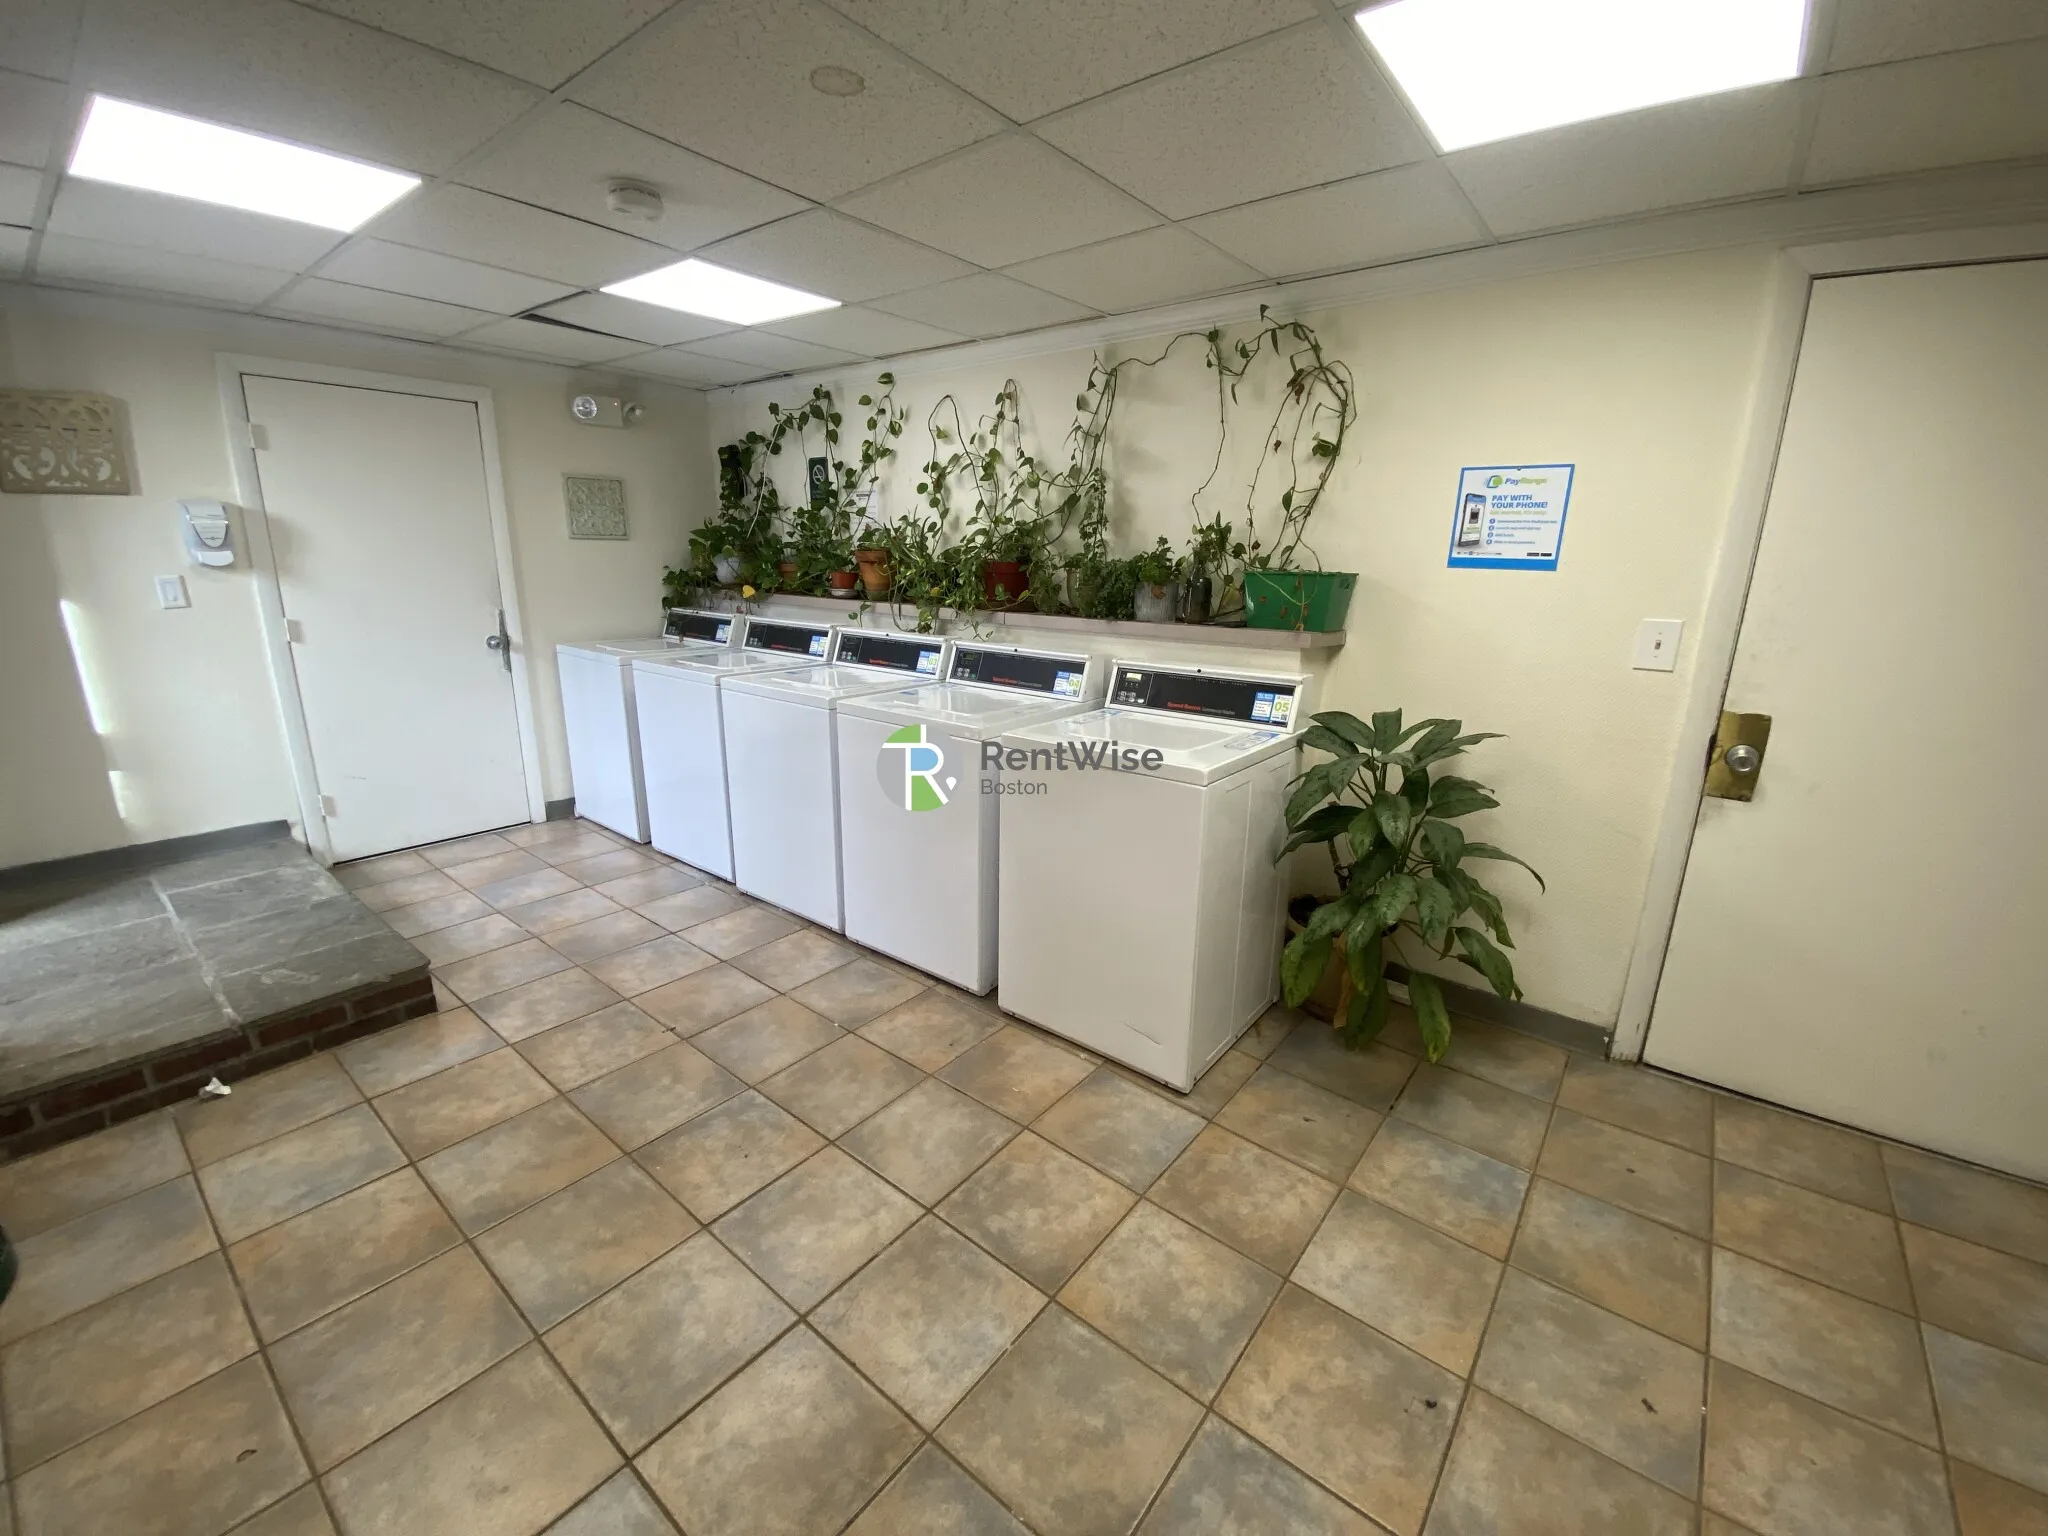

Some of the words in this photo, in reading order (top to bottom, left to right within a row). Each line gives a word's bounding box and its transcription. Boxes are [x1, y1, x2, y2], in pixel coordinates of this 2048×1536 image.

[1491, 494, 1510, 502] PAY
[1515, 501, 1549, 509] PHONE!
[1274, 701, 1290, 713] 05
